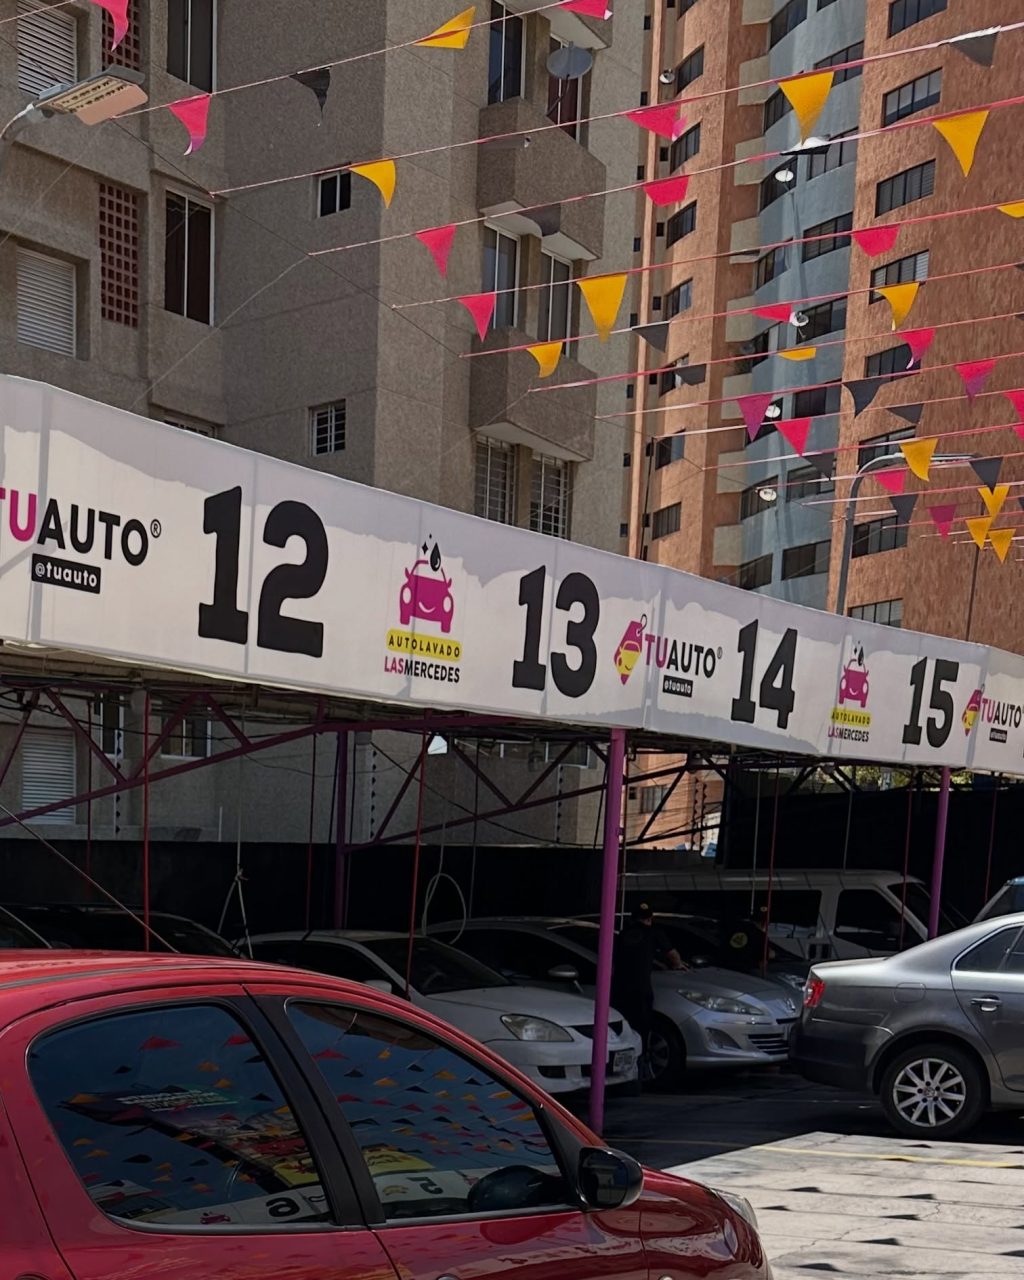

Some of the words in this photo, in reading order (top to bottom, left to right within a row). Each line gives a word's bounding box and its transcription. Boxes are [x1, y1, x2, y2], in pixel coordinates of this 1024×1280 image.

[34, 561, 98, 588] @tuauto
[198, 485, 330, 658] 12
[388, 634, 461, 658] AUTOLAVADO
[511, 564, 601, 698] 13
[730, 618, 799, 729] 14
[831, 711, 871, 725] AUTOLAVADO
[901, 655, 960, 749] 15
